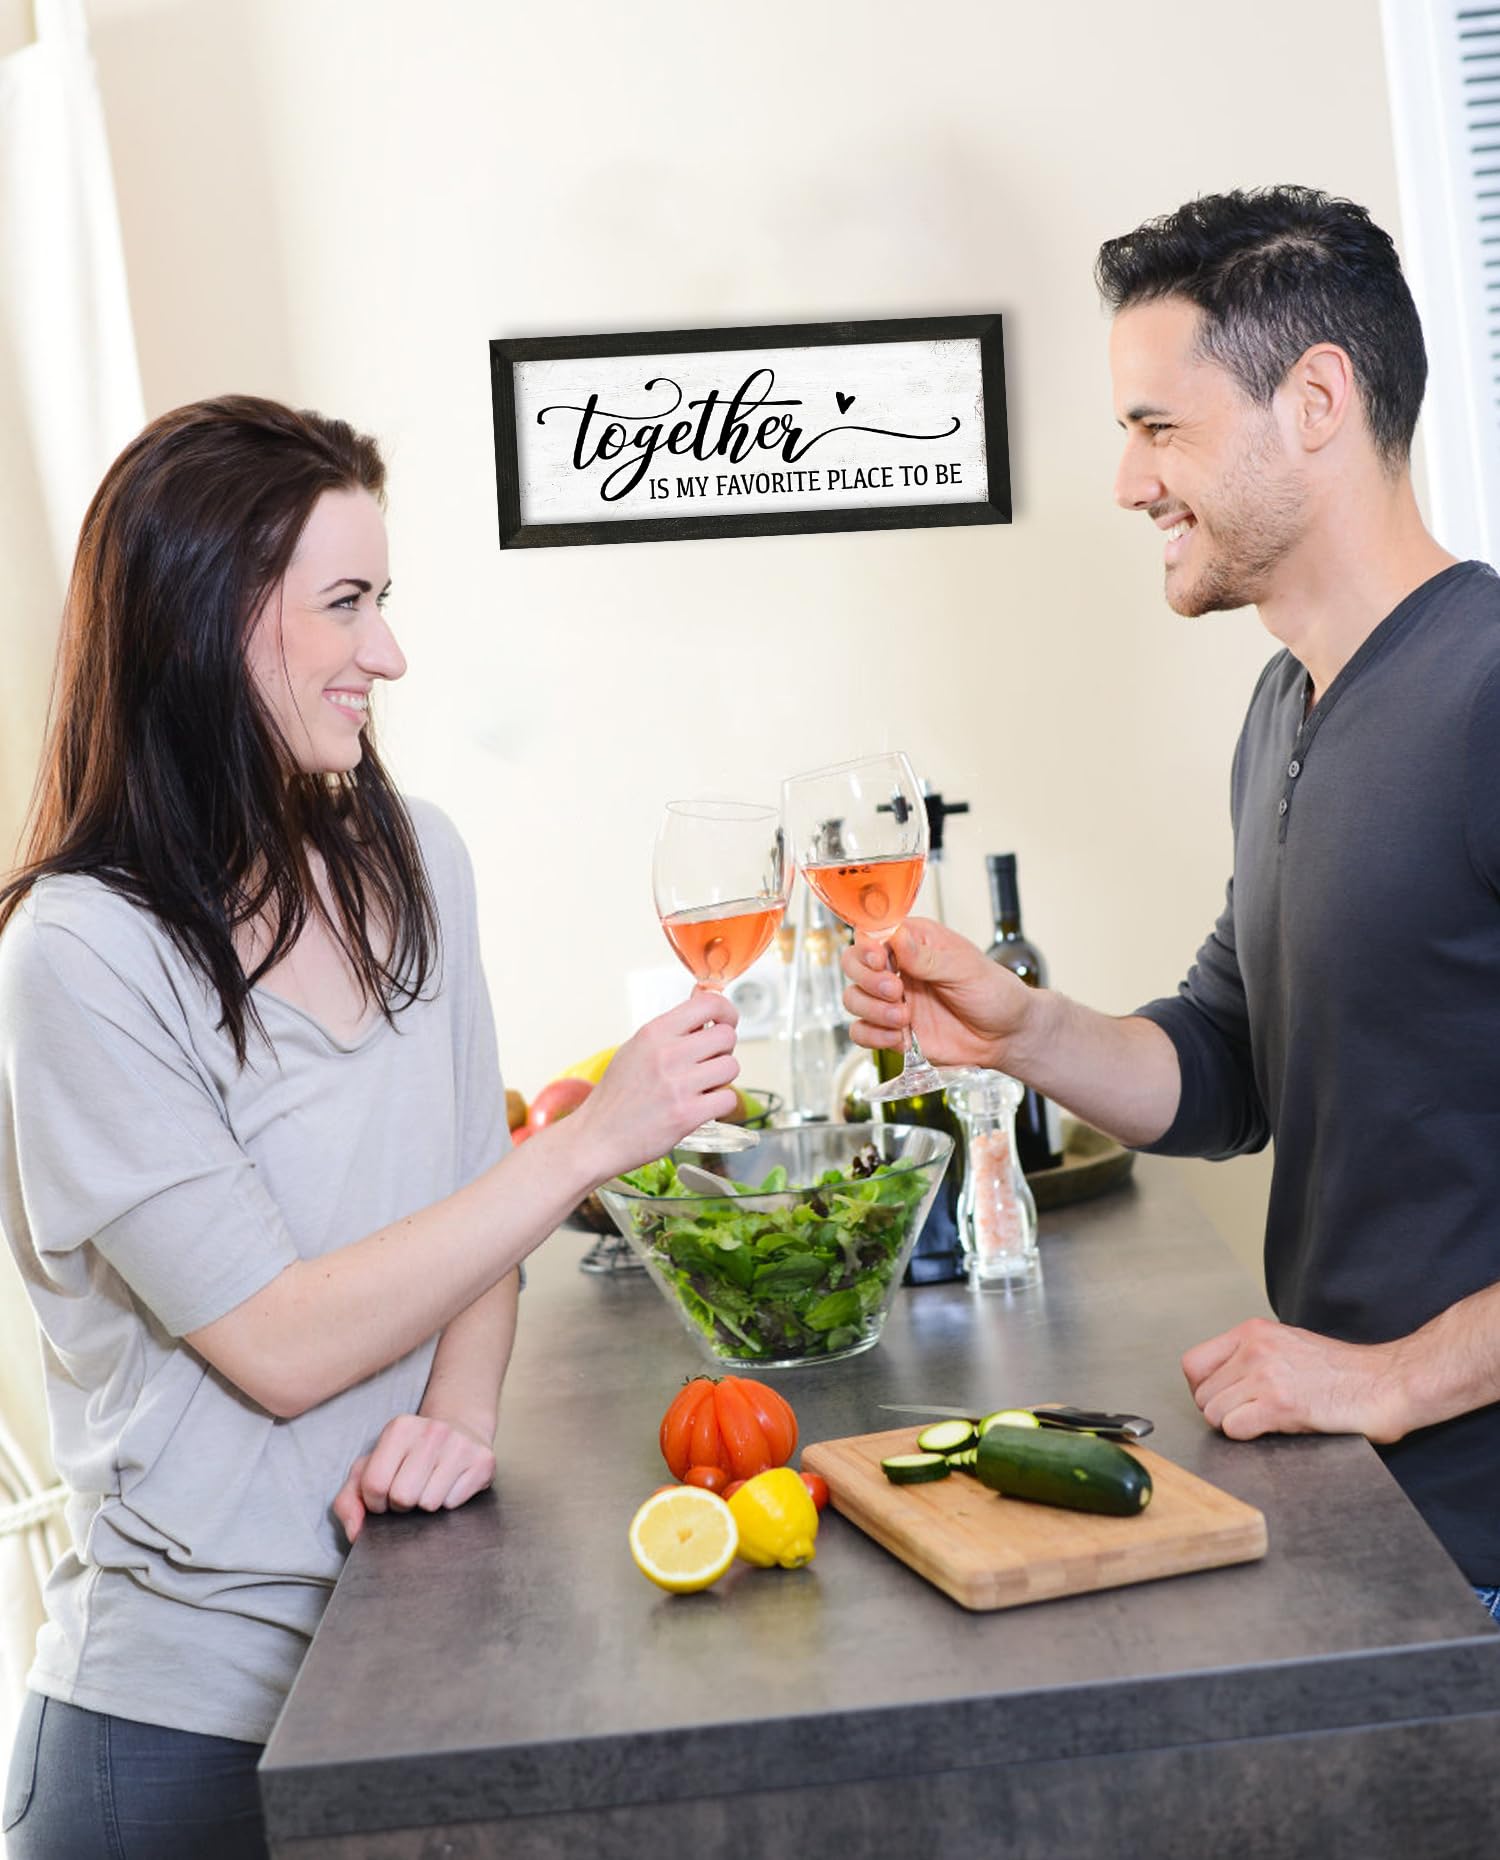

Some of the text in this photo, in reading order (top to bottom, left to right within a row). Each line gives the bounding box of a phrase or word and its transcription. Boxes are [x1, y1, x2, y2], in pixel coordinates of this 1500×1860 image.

[537, 368, 961, 502] together
[648, 462, 963, 500] IS MY FAVORITE PLACE TO BE
